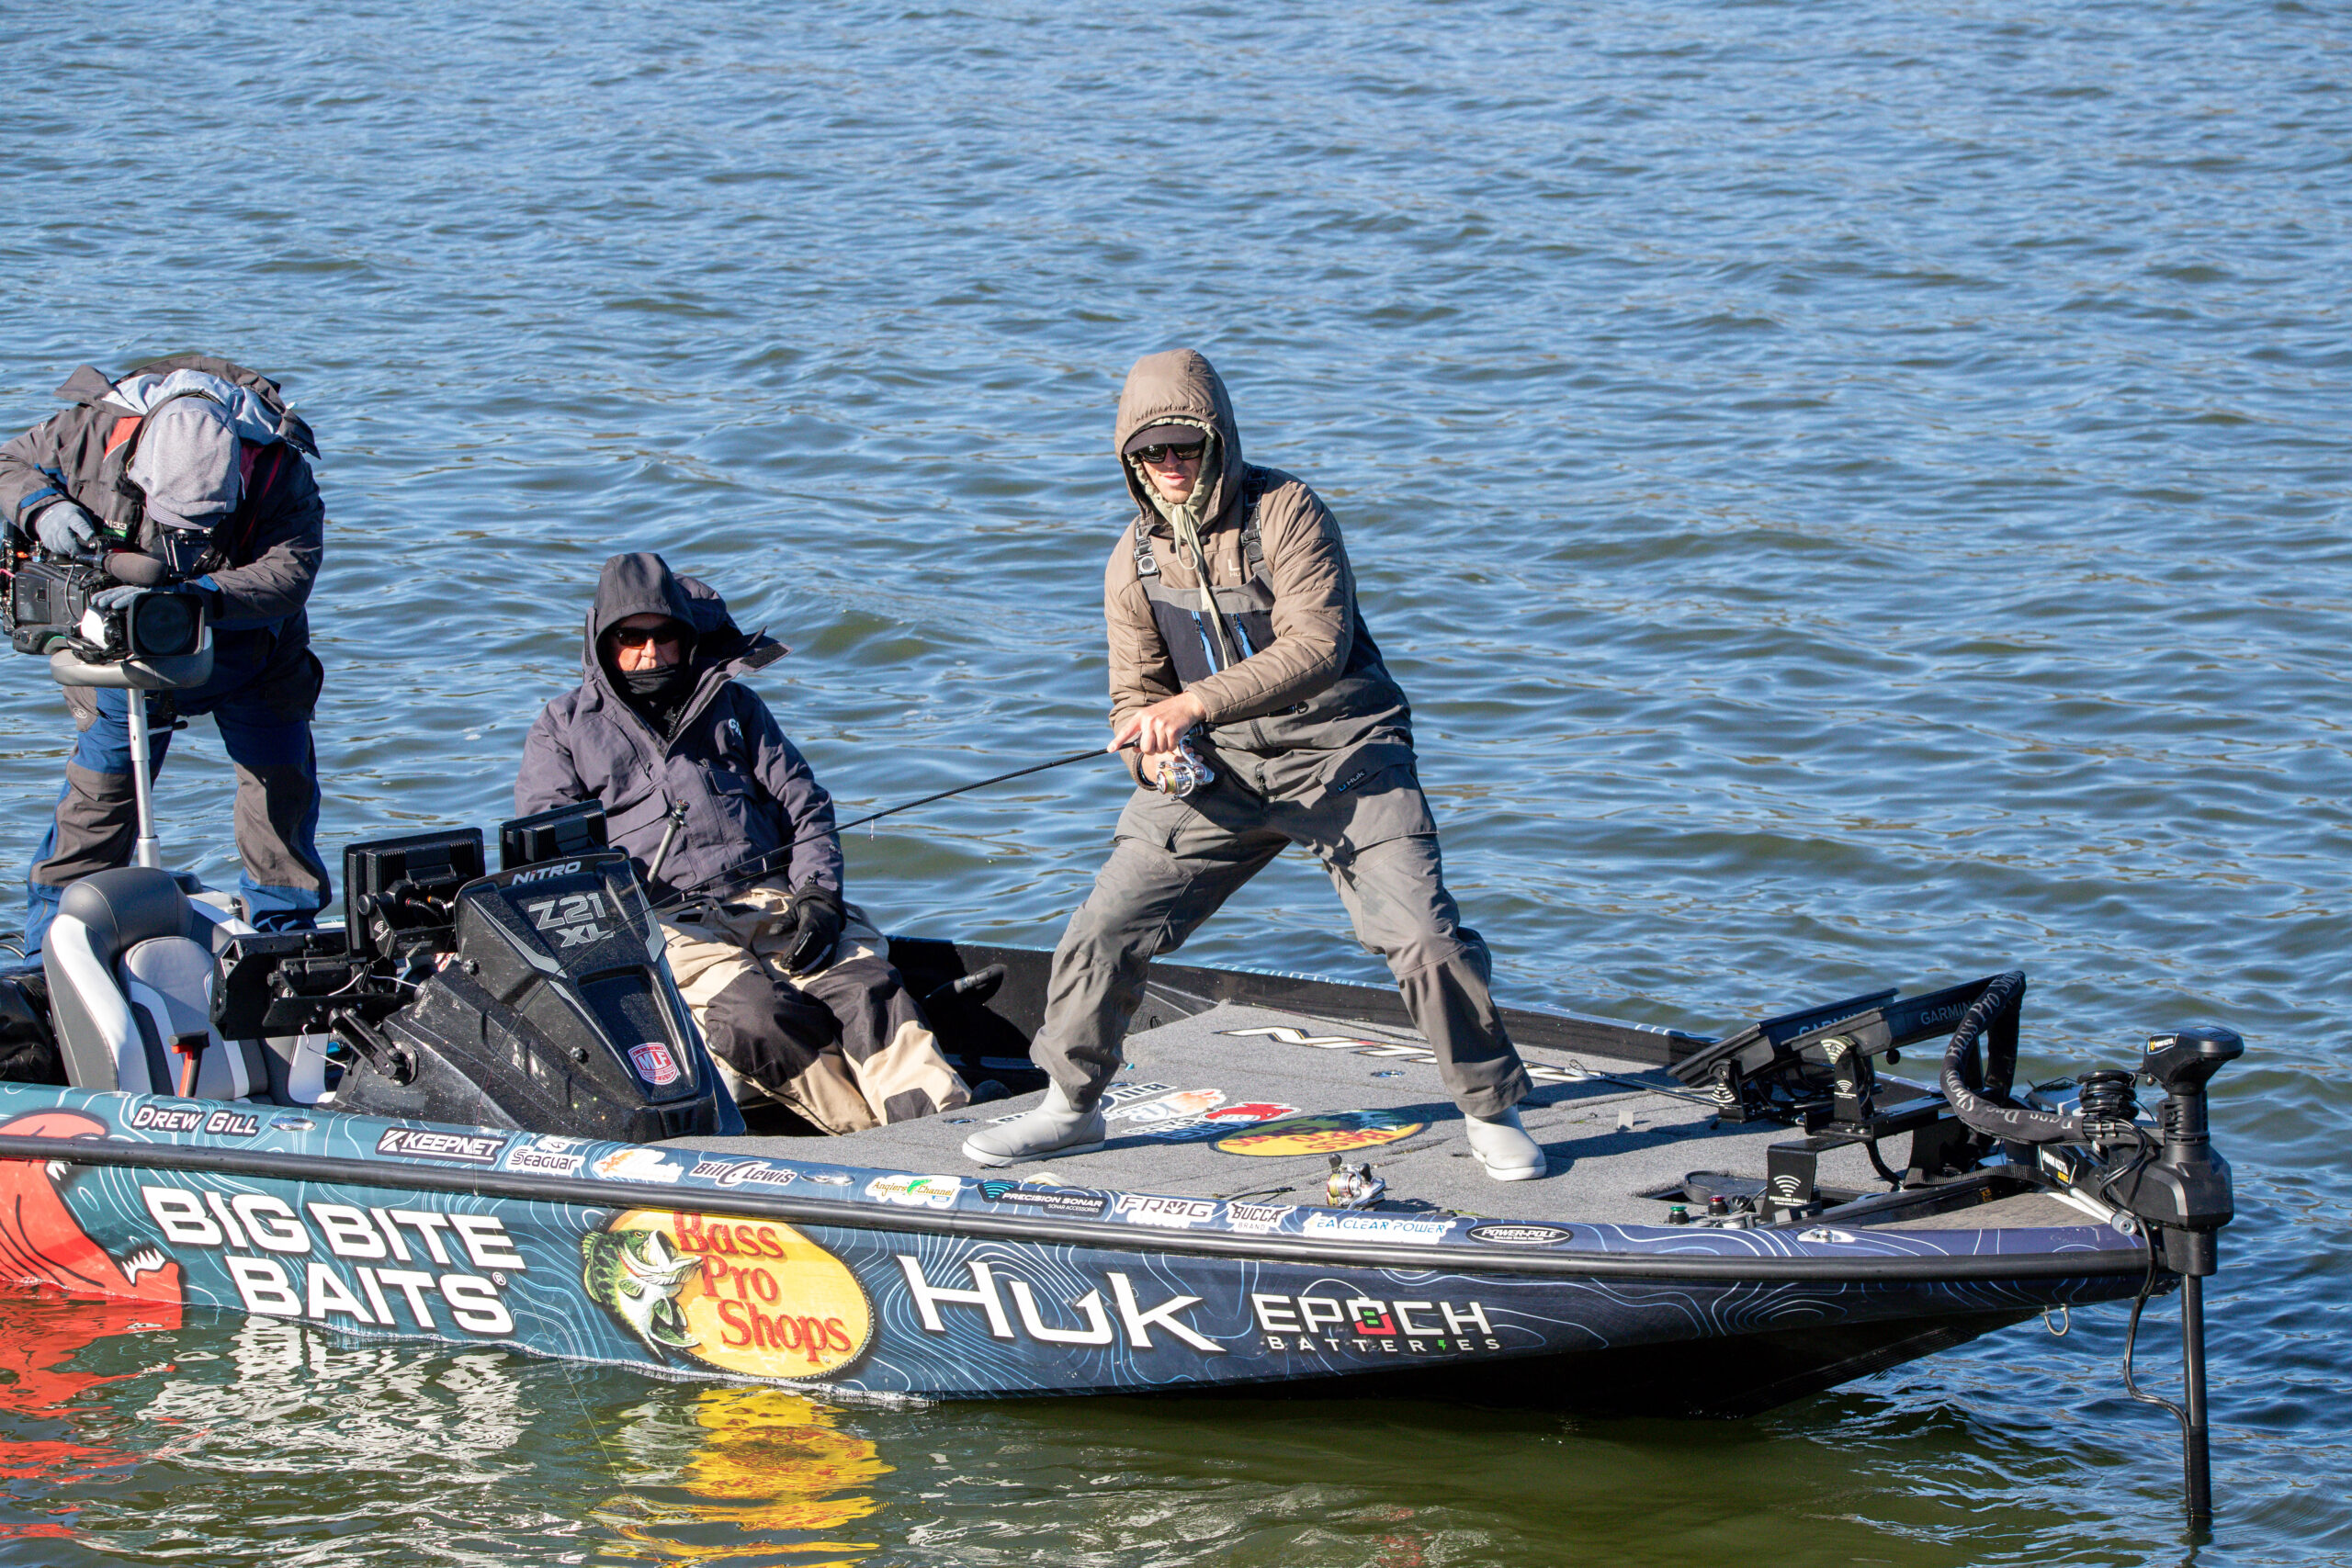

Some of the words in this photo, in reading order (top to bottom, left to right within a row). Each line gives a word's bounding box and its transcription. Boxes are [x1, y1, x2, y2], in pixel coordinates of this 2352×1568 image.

[528, 893, 606, 931] Z21
[555, 923, 615, 947] XL
[637, 1051, 670, 1070] MLF
[132, 1107, 203, 1129] DREW
[206, 1111, 259, 1134] GILL
[401, 1133, 504, 1156] KEEPNET
[692, 1162, 728, 1176] Bill
[742, 1167, 796, 1184] Lewis
[917, 1185, 956, 1197] Channel
[1001, 1192, 1061, 1203] PRECISION
[1062, 1197, 1103, 1207] SONAR
[1232, 1204, 1284, 1223] BUCCA
[141, 1186, 311, 1253] BIG
[308, 1201, 526, 1269] BITE
[673, 1211, 784, 1258] Bass
[1238, 1223, 1266, 1231] BRAND
[1342, 1219, 1390, 1231] CLEAR
[1394, 1222, 1446, 1235] POWER
[1481, 1228, 1558, 1239] POWER-POLE
[695, 1253, 779, 1302] Pro
[1251, 1293, 1493, 1336] EPOCH
[717, 1298, 852, 1362] Shops
